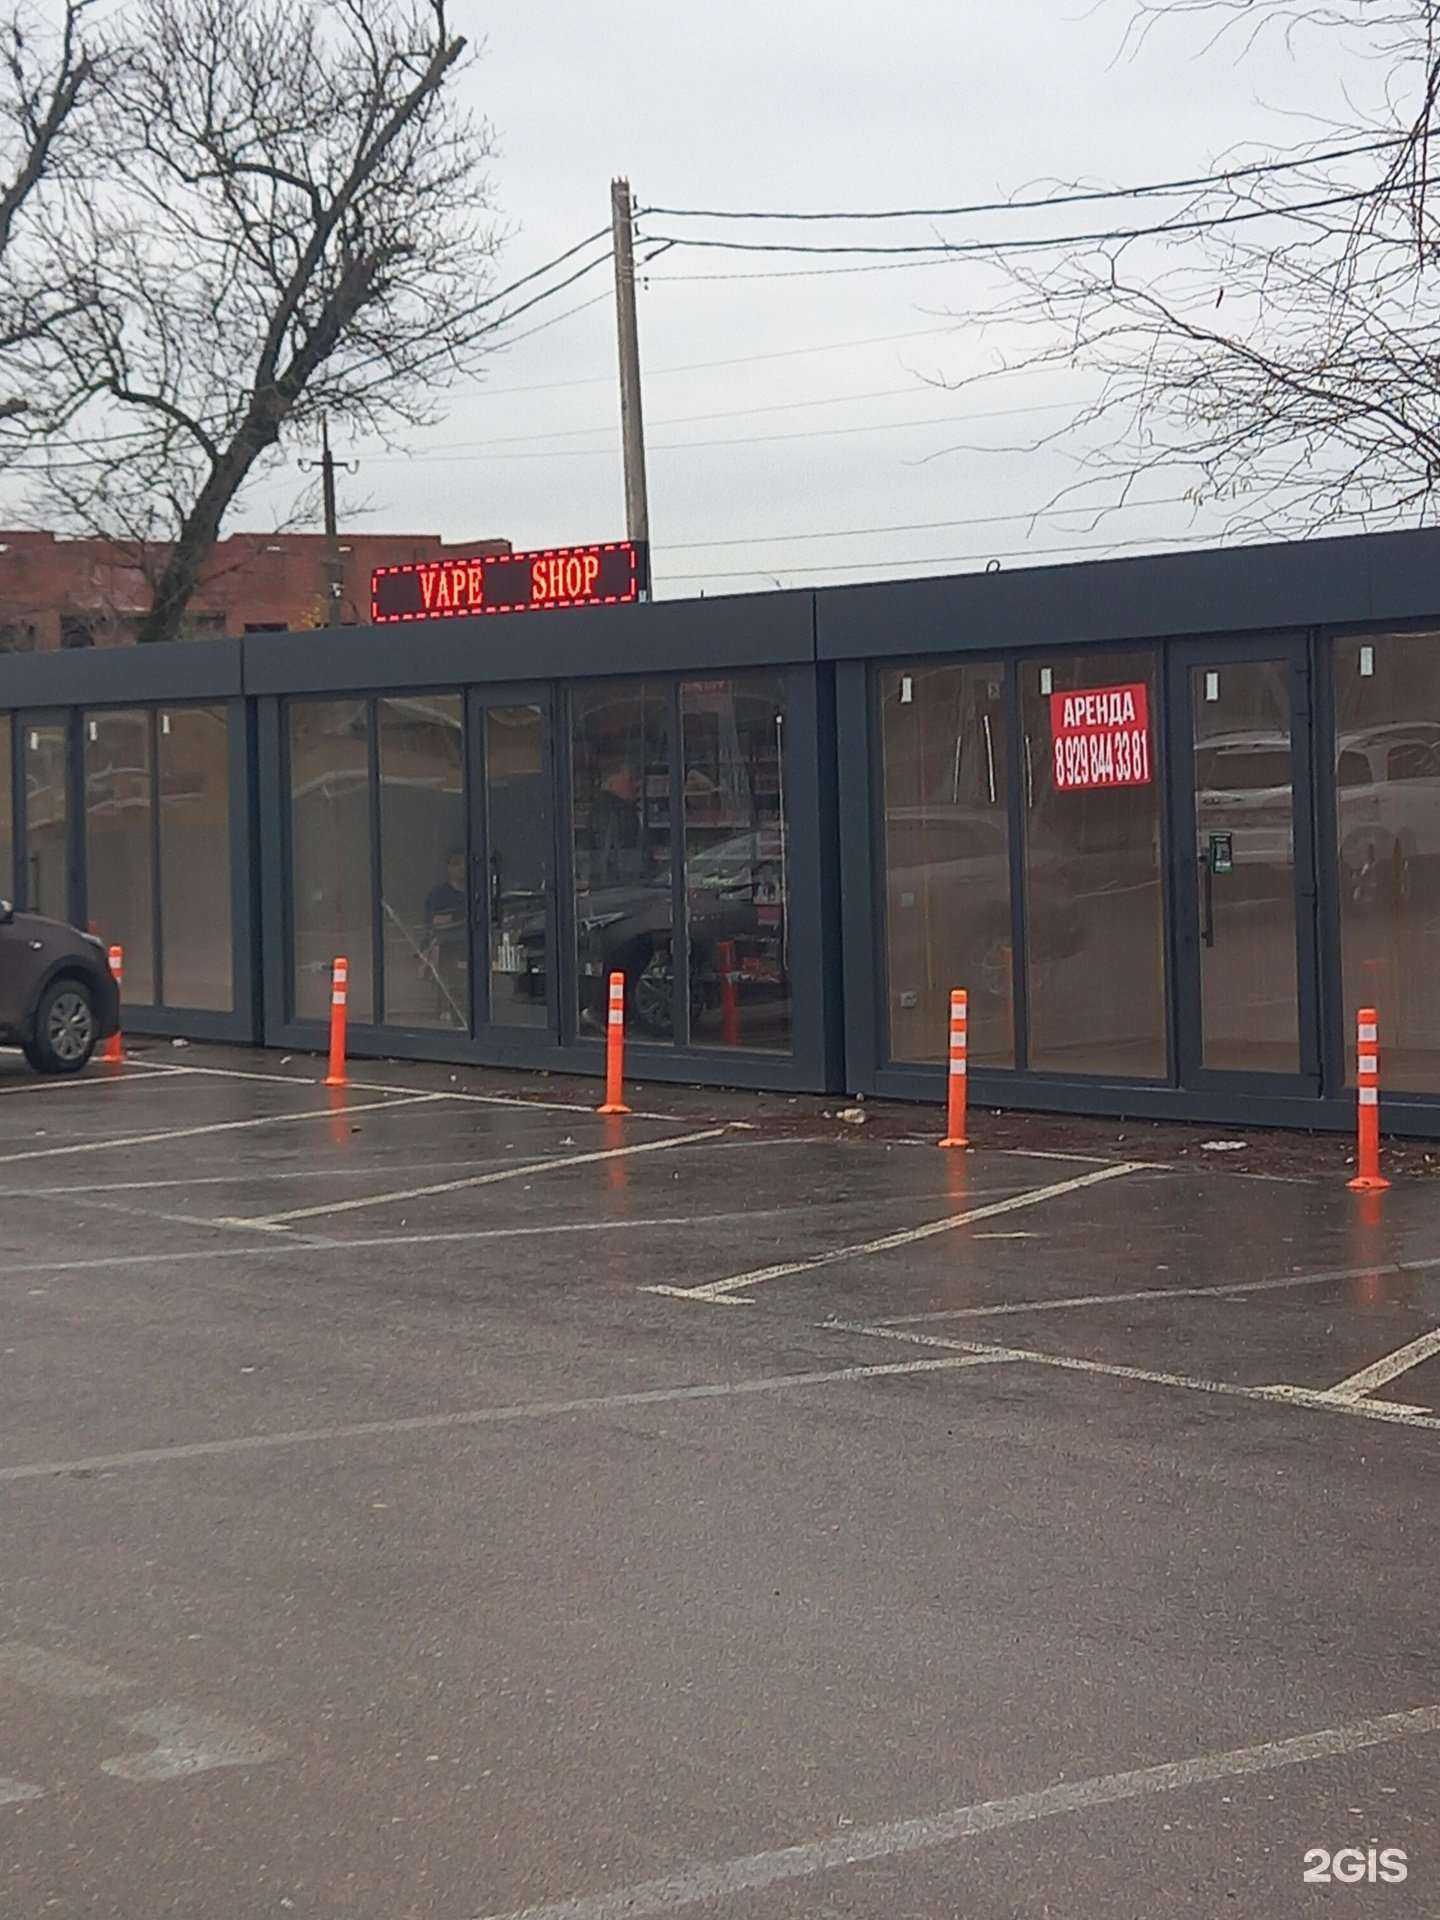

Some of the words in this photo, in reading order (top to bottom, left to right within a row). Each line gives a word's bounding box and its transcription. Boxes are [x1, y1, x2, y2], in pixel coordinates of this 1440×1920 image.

[420, 567, 483, 608] VAPE
[532, 556, 599, 600] SHOP
[1063, 691, 1136, 727] АРЕНДА
